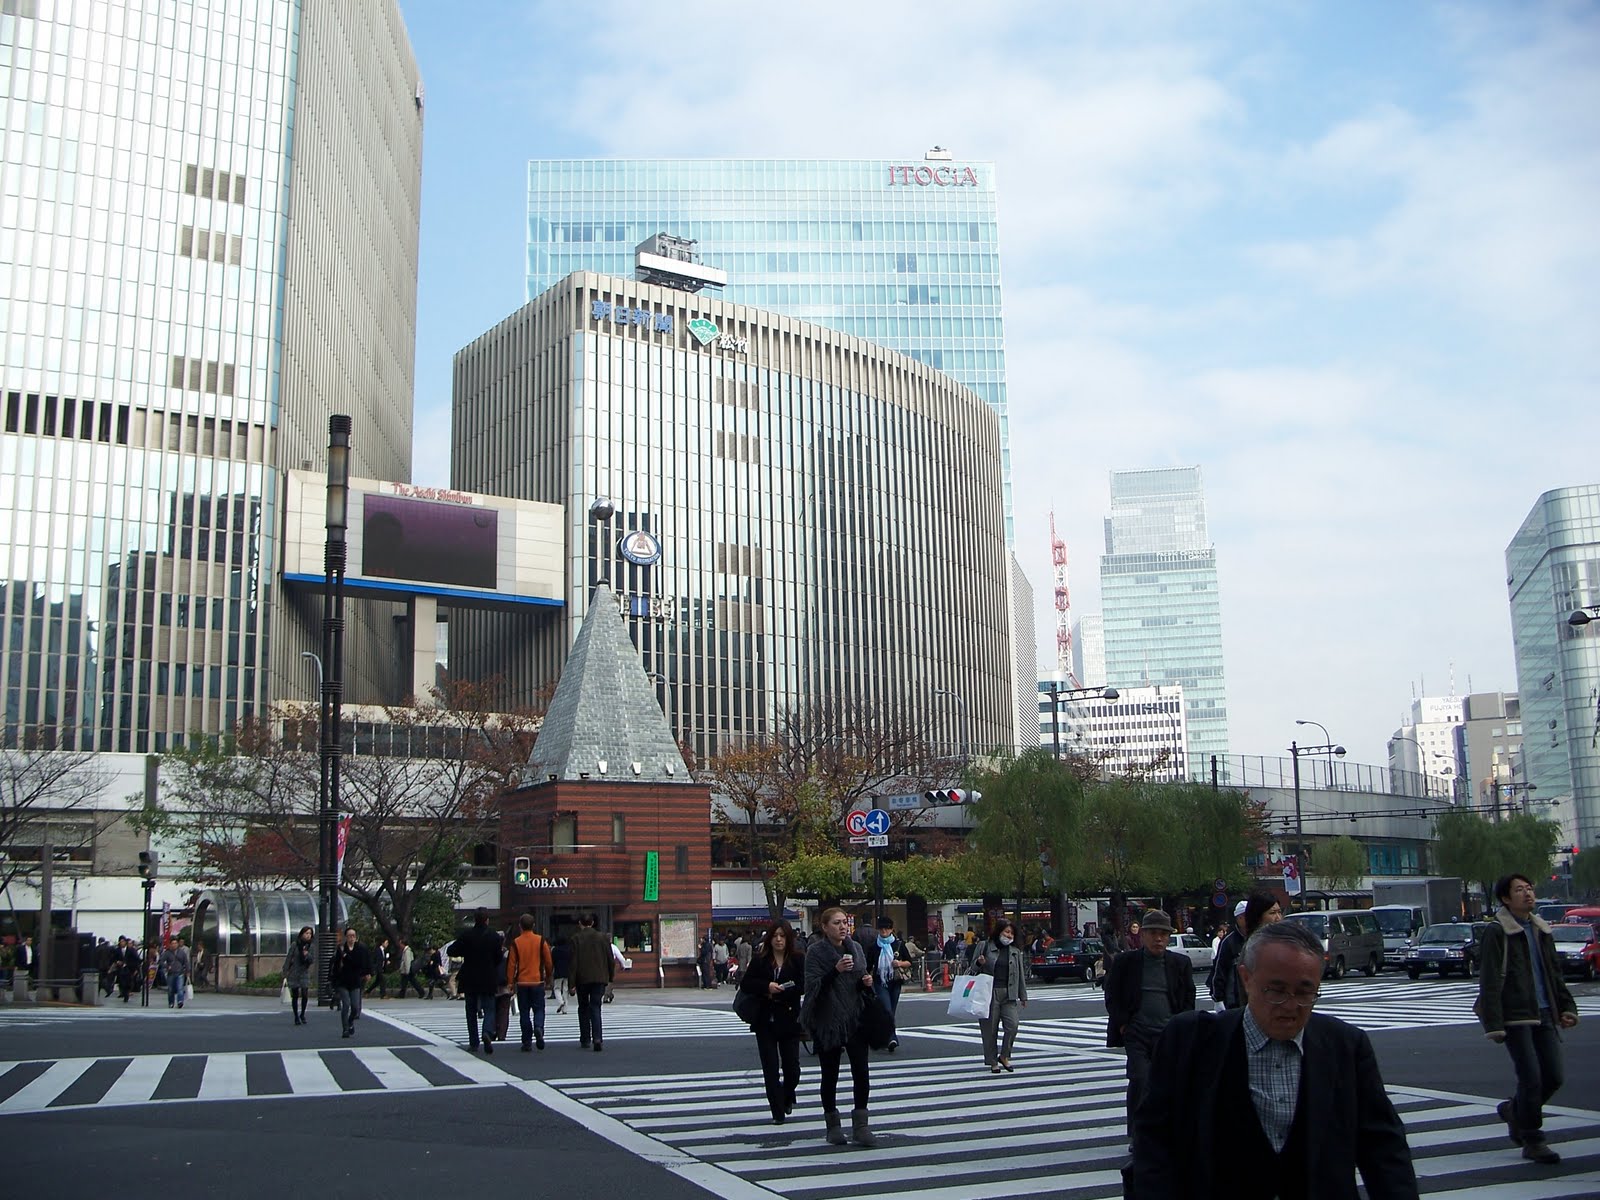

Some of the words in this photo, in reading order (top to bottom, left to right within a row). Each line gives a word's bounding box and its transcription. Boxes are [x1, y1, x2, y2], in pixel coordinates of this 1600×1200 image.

[592, 299, 673, 334] 朝日新聞
[391, 481, 409, 496] The
[410, 486, 435, 500] Asahi
[437, 489, 473, 504] Shimbun
